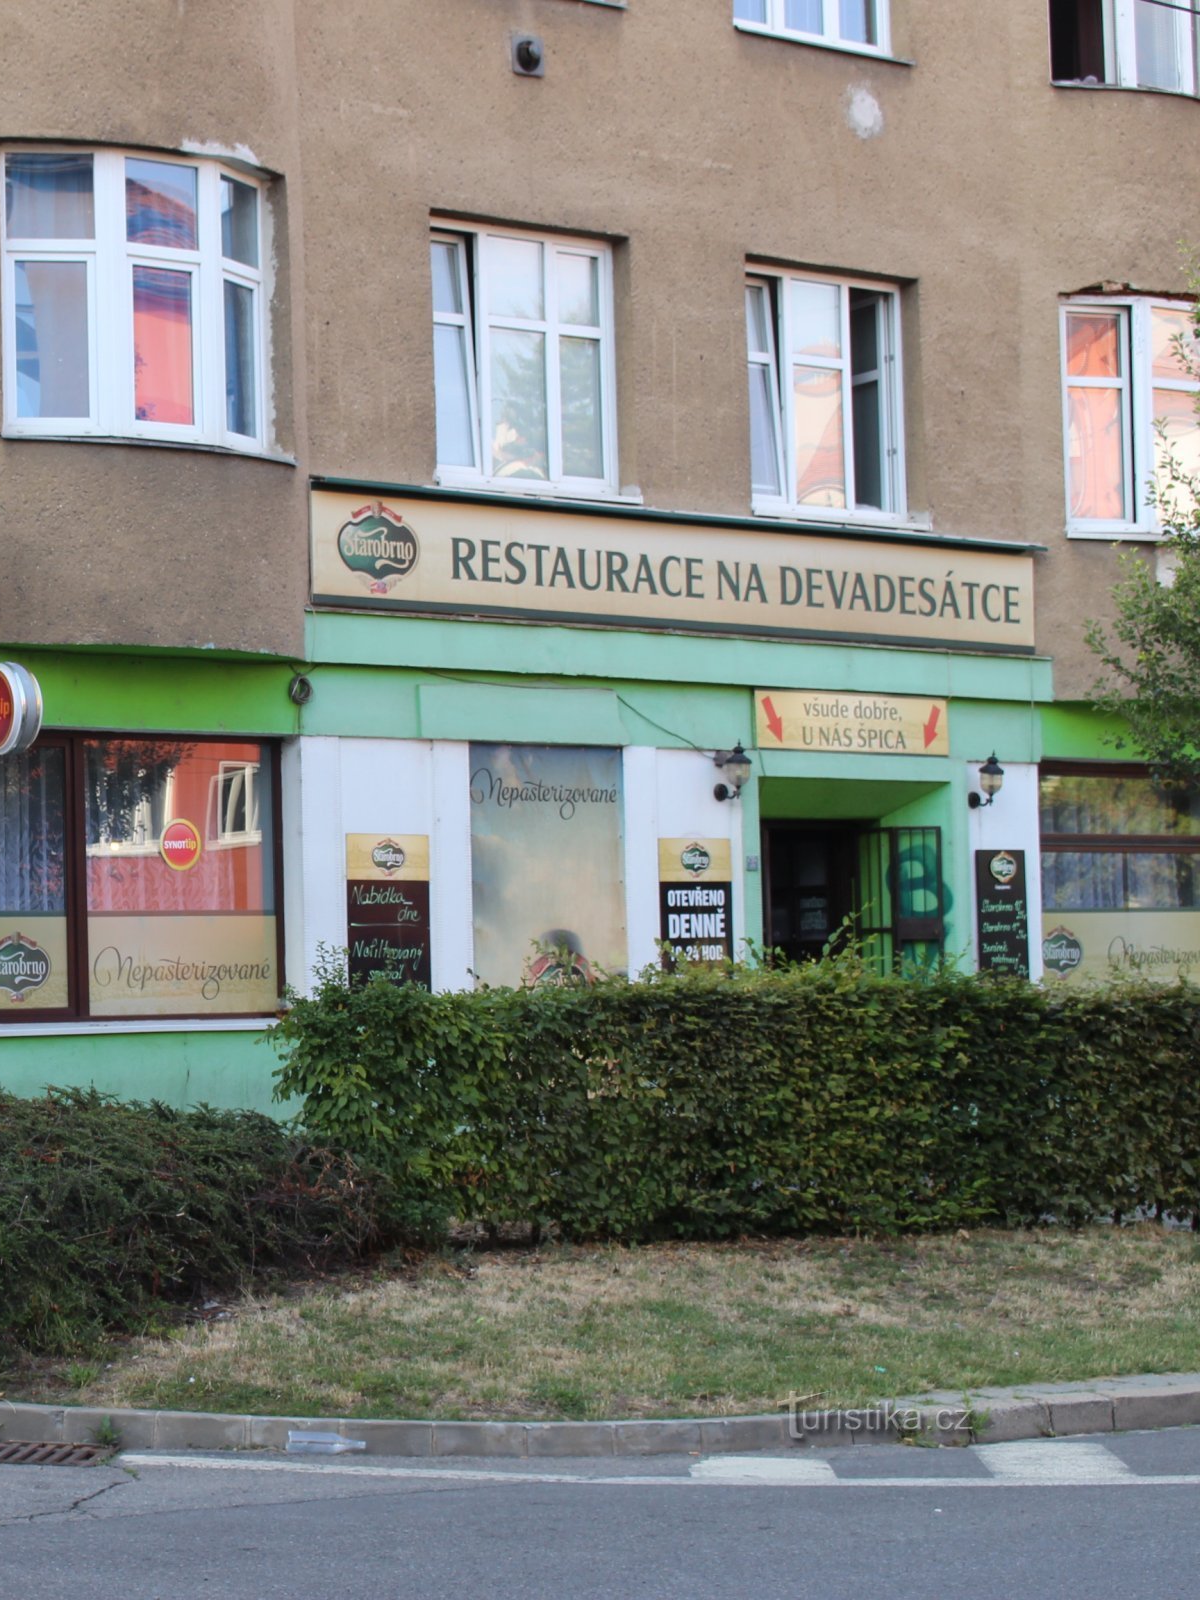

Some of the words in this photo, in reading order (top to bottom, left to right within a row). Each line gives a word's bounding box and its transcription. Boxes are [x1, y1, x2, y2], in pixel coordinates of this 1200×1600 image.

[343, 527, 414, 570] Starobrno
[450, 537, 705, 599] RESTAURACE
[717, 560, 769, 604] NA
[779, 565, 1021, 625] DEVADESÁTCE
[803, 697, 849, 718] všude
[853, 700, 903, 722] dobře,
[802, 726, 813, 746] U
[818, 723, 853, 748] NÁS
[857, 723, 907, 750] ŠPICA
[470, 768, 617, 820] Nepasterizované
[667, 886, 726, 907] OTEVŘENO
[668, 908, 726, 939] DENNĚ
[93, 946, 271, 1000] Nepasterizované
